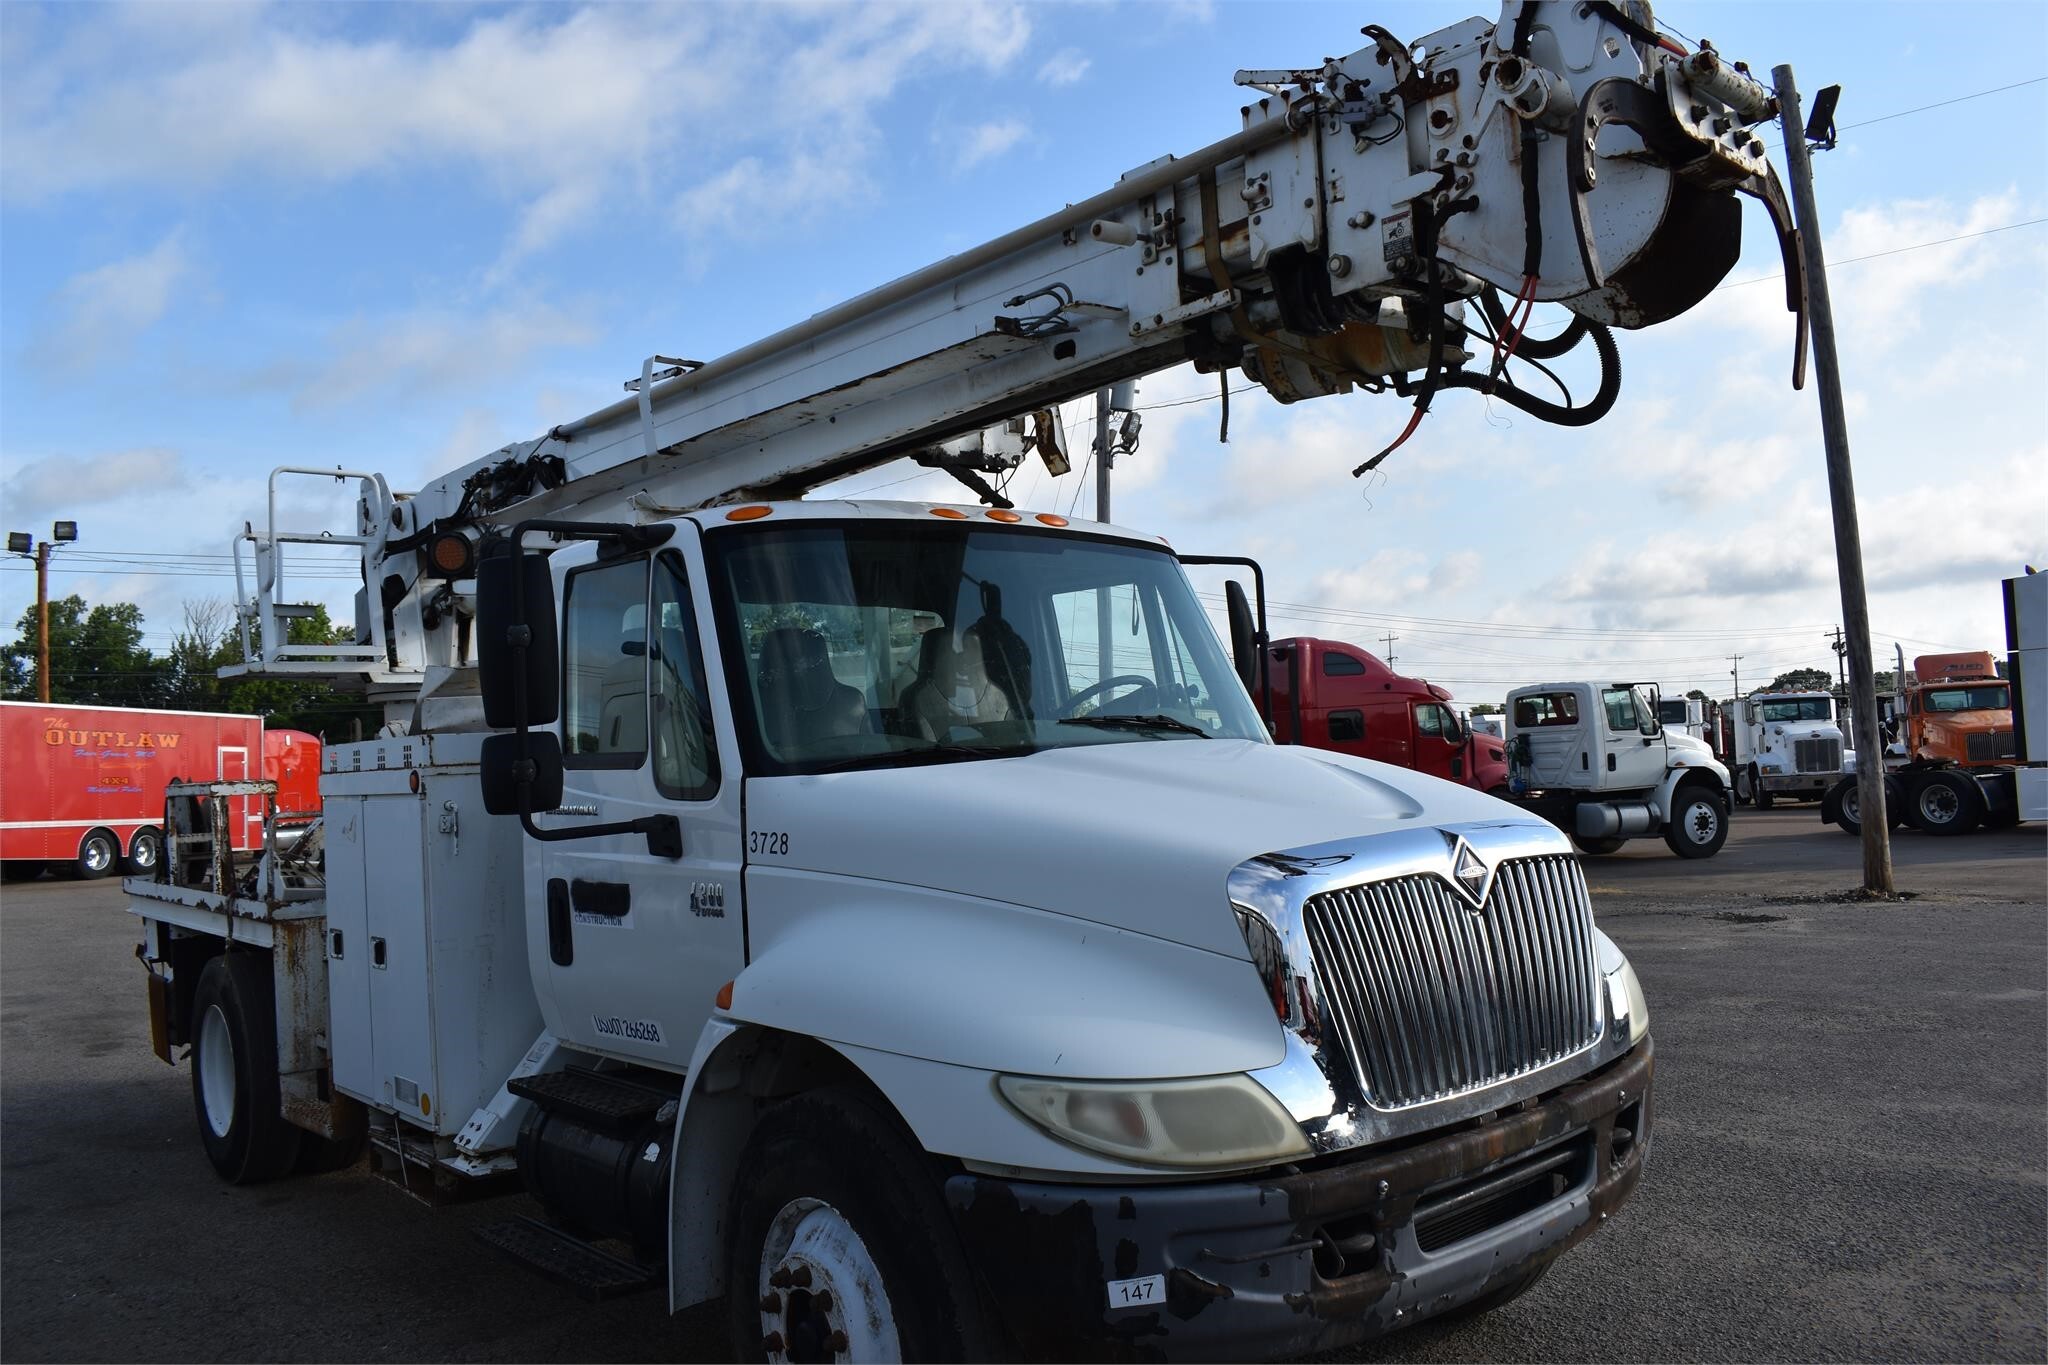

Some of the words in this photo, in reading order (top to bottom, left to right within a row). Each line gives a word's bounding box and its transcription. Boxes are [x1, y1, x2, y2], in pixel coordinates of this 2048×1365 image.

[43, 717, 70, 729] The
[44, 729, 181, 748] OUTLAW
[750, 831, 789, 855] 3728
[690, 881, 724, 909] 4300
[574, 913, 623, 927] CONSTRUCTION
[623, 1020, 661, 1042] 266268
[1121, 1282, 1154, 1302] 147
